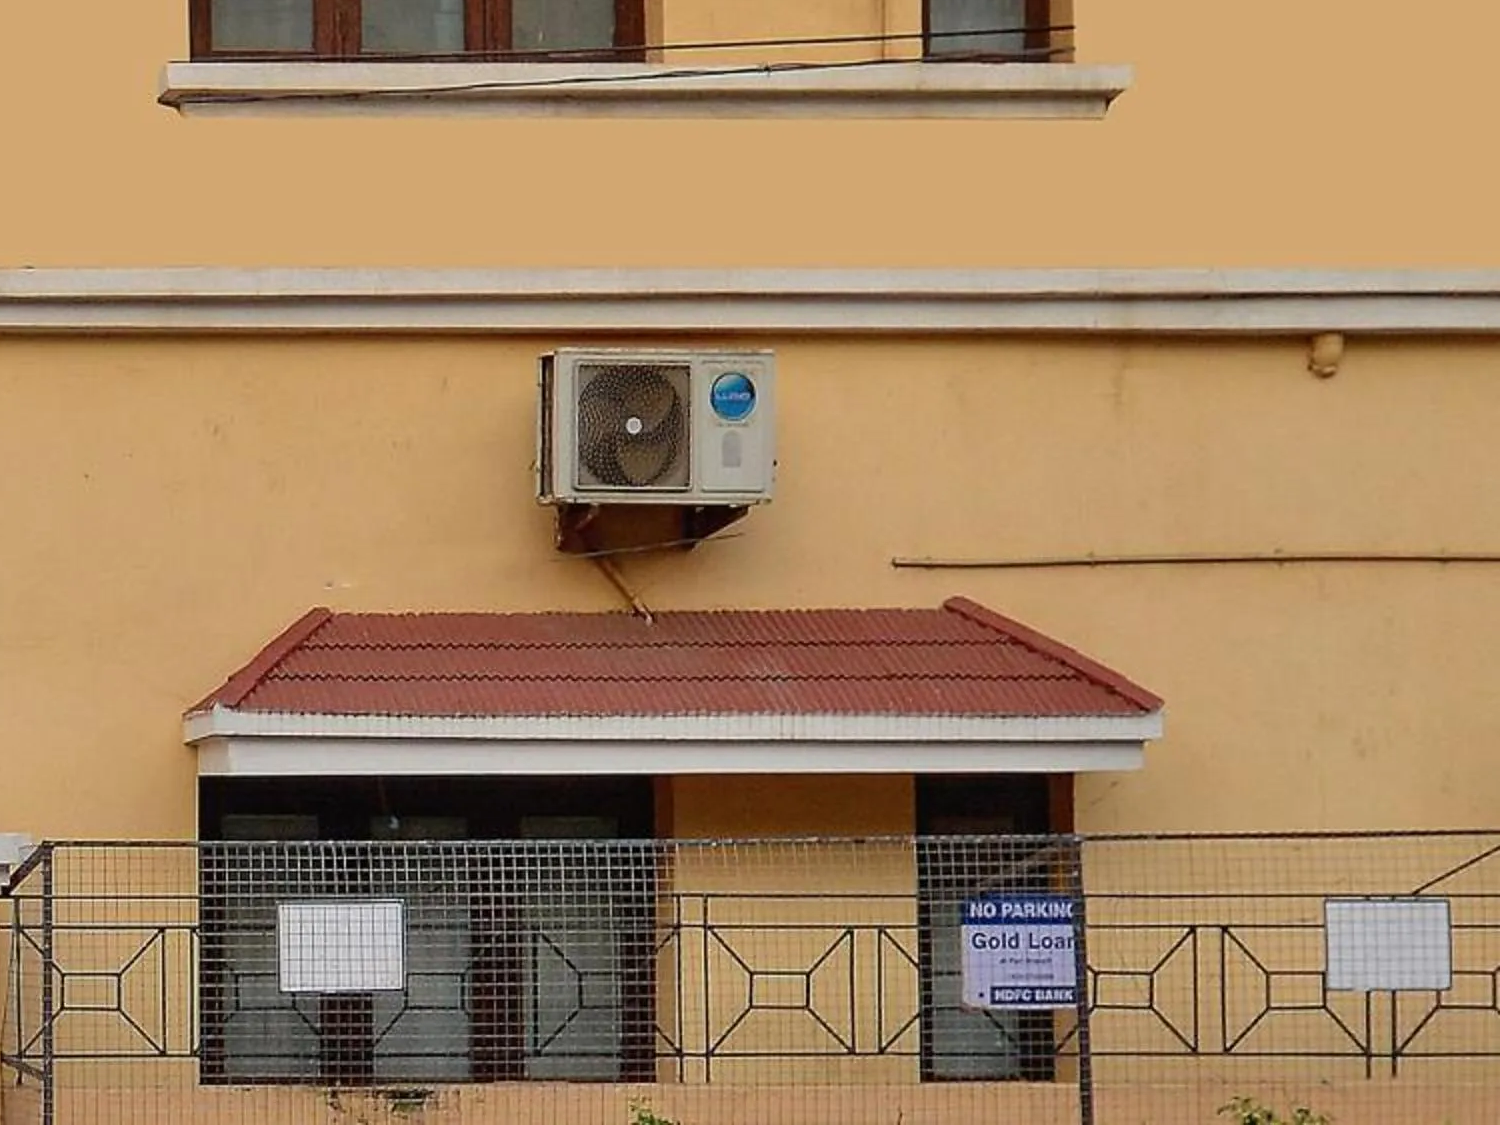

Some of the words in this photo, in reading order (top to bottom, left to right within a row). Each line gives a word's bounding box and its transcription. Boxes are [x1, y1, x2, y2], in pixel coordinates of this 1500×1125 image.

[970, 901, 997, 918] NO
[972, 932, 1020, 950] Gold
[995, 989, 1032, 1001] HDFC
[1035, 989, 1073, 1001] BANK
